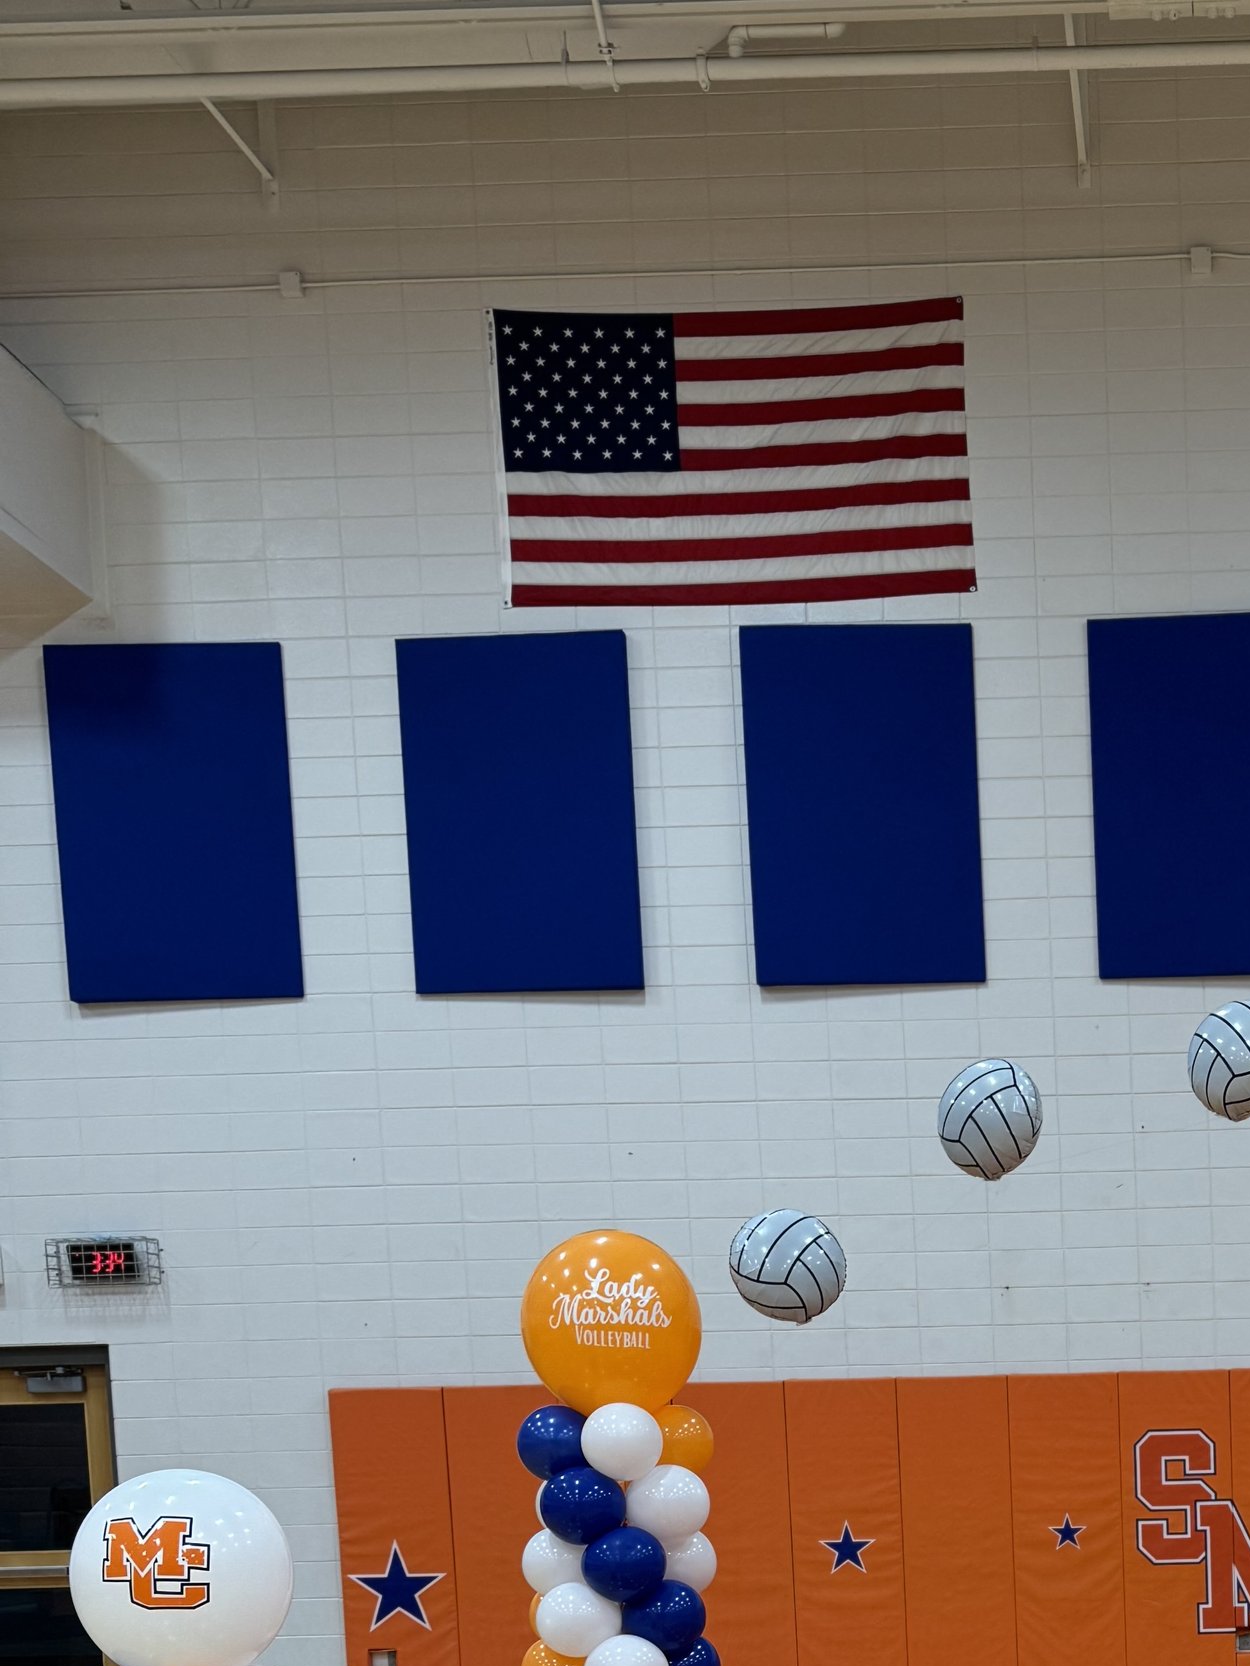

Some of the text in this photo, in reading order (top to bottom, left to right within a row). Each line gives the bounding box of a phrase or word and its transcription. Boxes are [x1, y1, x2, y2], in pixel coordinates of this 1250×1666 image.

[583, 1268, 657, 1307] Lady
[549, 1293, 672, 1329] Marshals
[575, 1324, 651, 1349] VOLLEYBALL
[102, 1516, 211, 1610] MC
